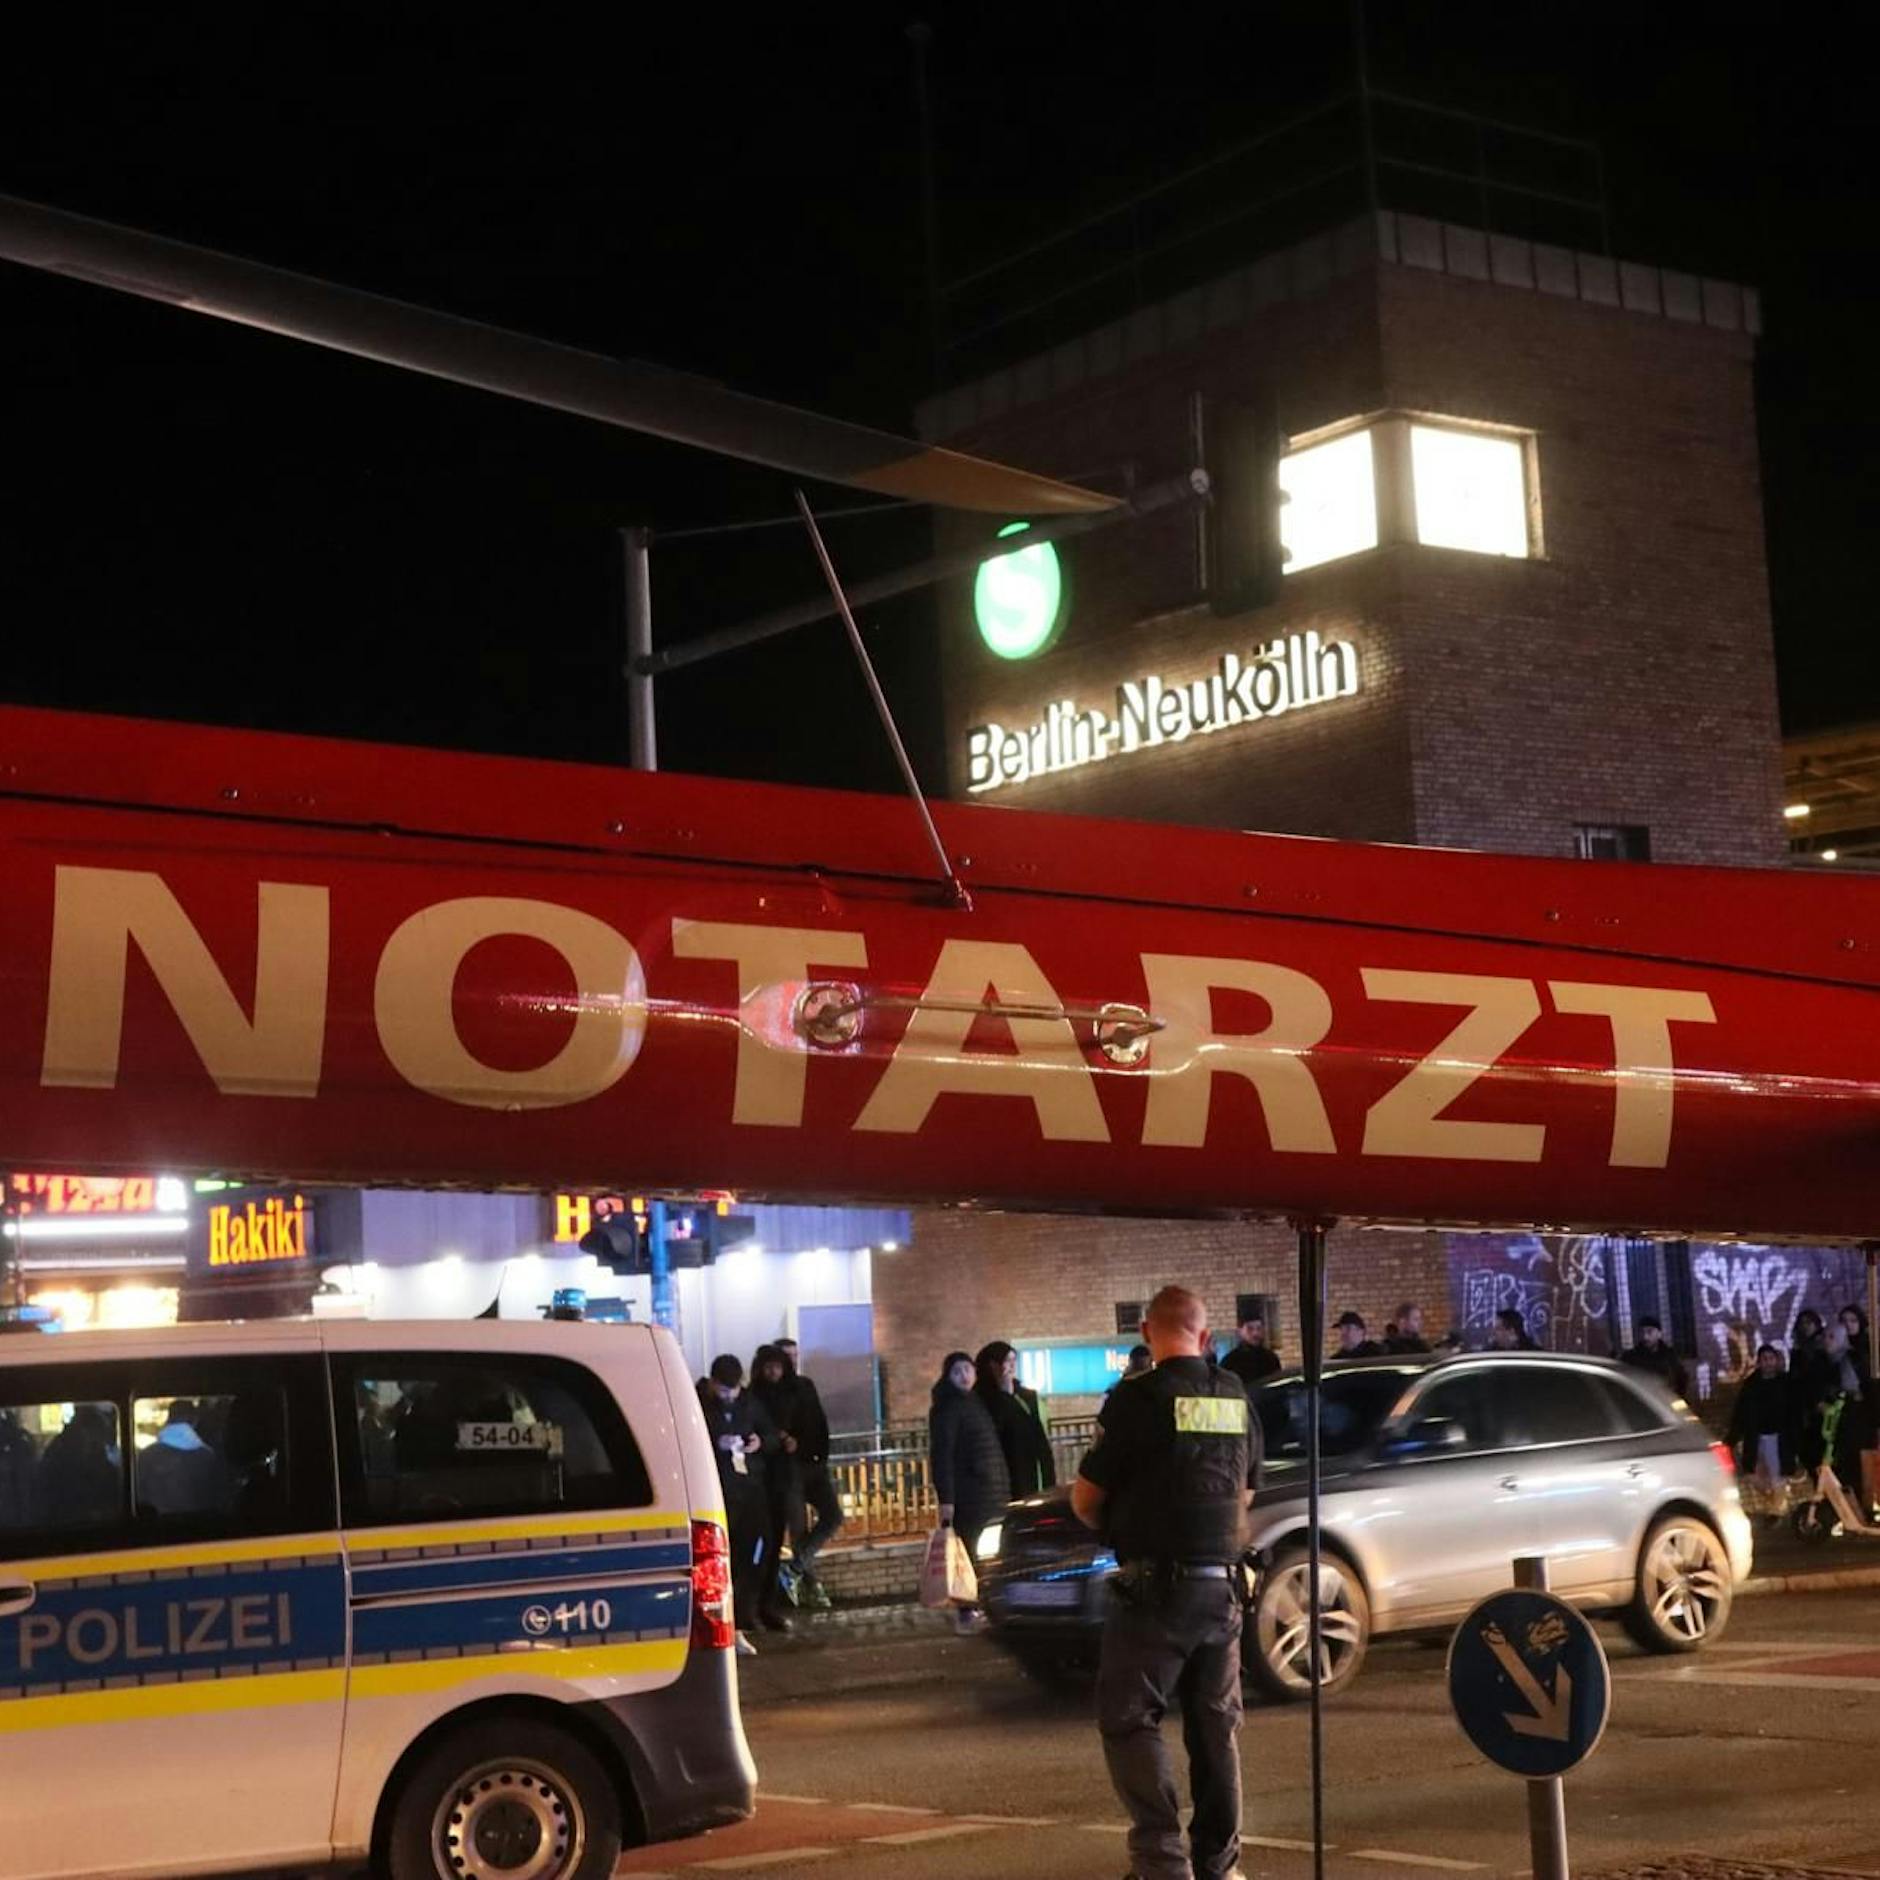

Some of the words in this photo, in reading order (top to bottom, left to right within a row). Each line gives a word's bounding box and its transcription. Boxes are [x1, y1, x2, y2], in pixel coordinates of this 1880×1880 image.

[967, 631, 1357, 792] Berlin-Neukölln
[40, 865, 1718, 1169] NOTARZT
[209, 1194, 306, 1267] Hakiki
[472, 1426, 534, 1446] 54-04
[18, 1592, 293, 1670] POLIZEI
[555, 1599, 612, 1632] 110
